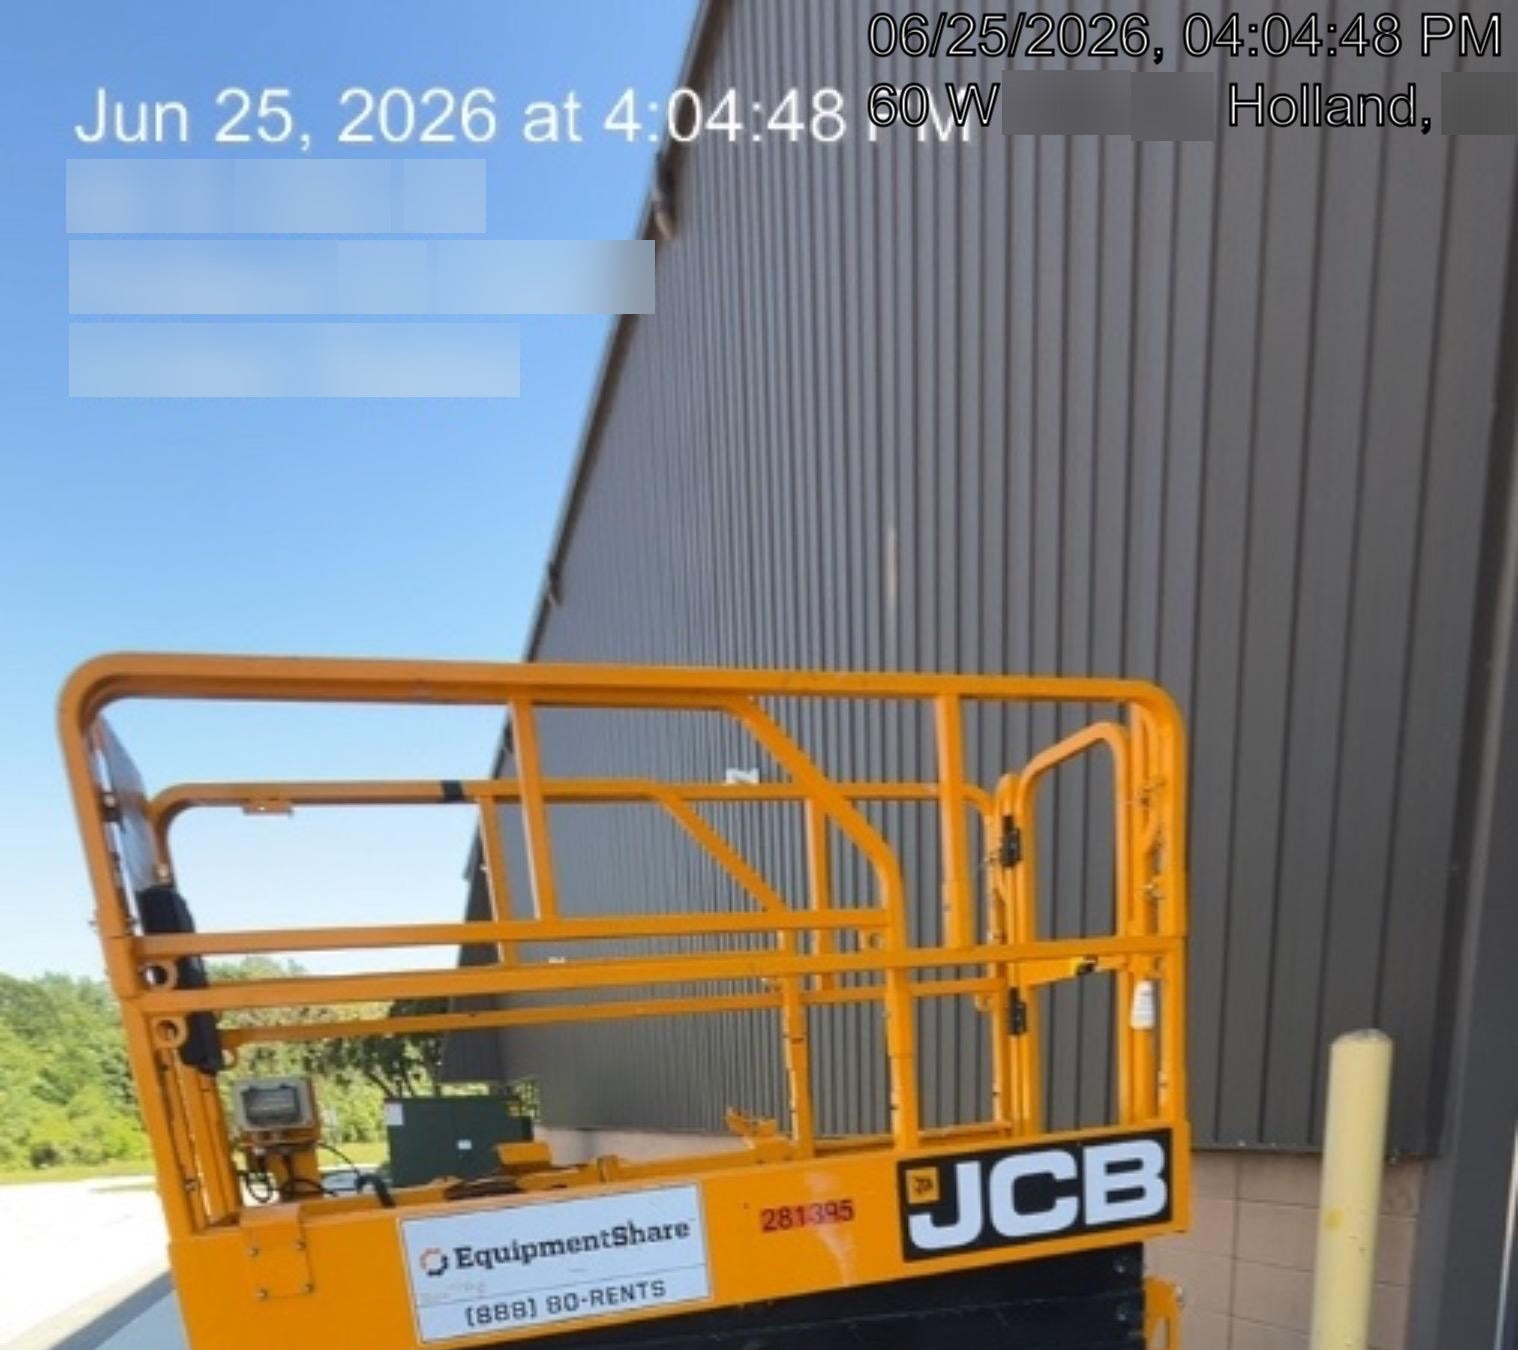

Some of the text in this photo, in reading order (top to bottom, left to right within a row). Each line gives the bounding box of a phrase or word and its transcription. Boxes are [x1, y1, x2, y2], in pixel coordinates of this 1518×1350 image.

[761, 1199, 855, 1232] 281395
[908, 1139, 1168, 1250] JCB
[454, 1219, 690, 1270] EquipmentShare
